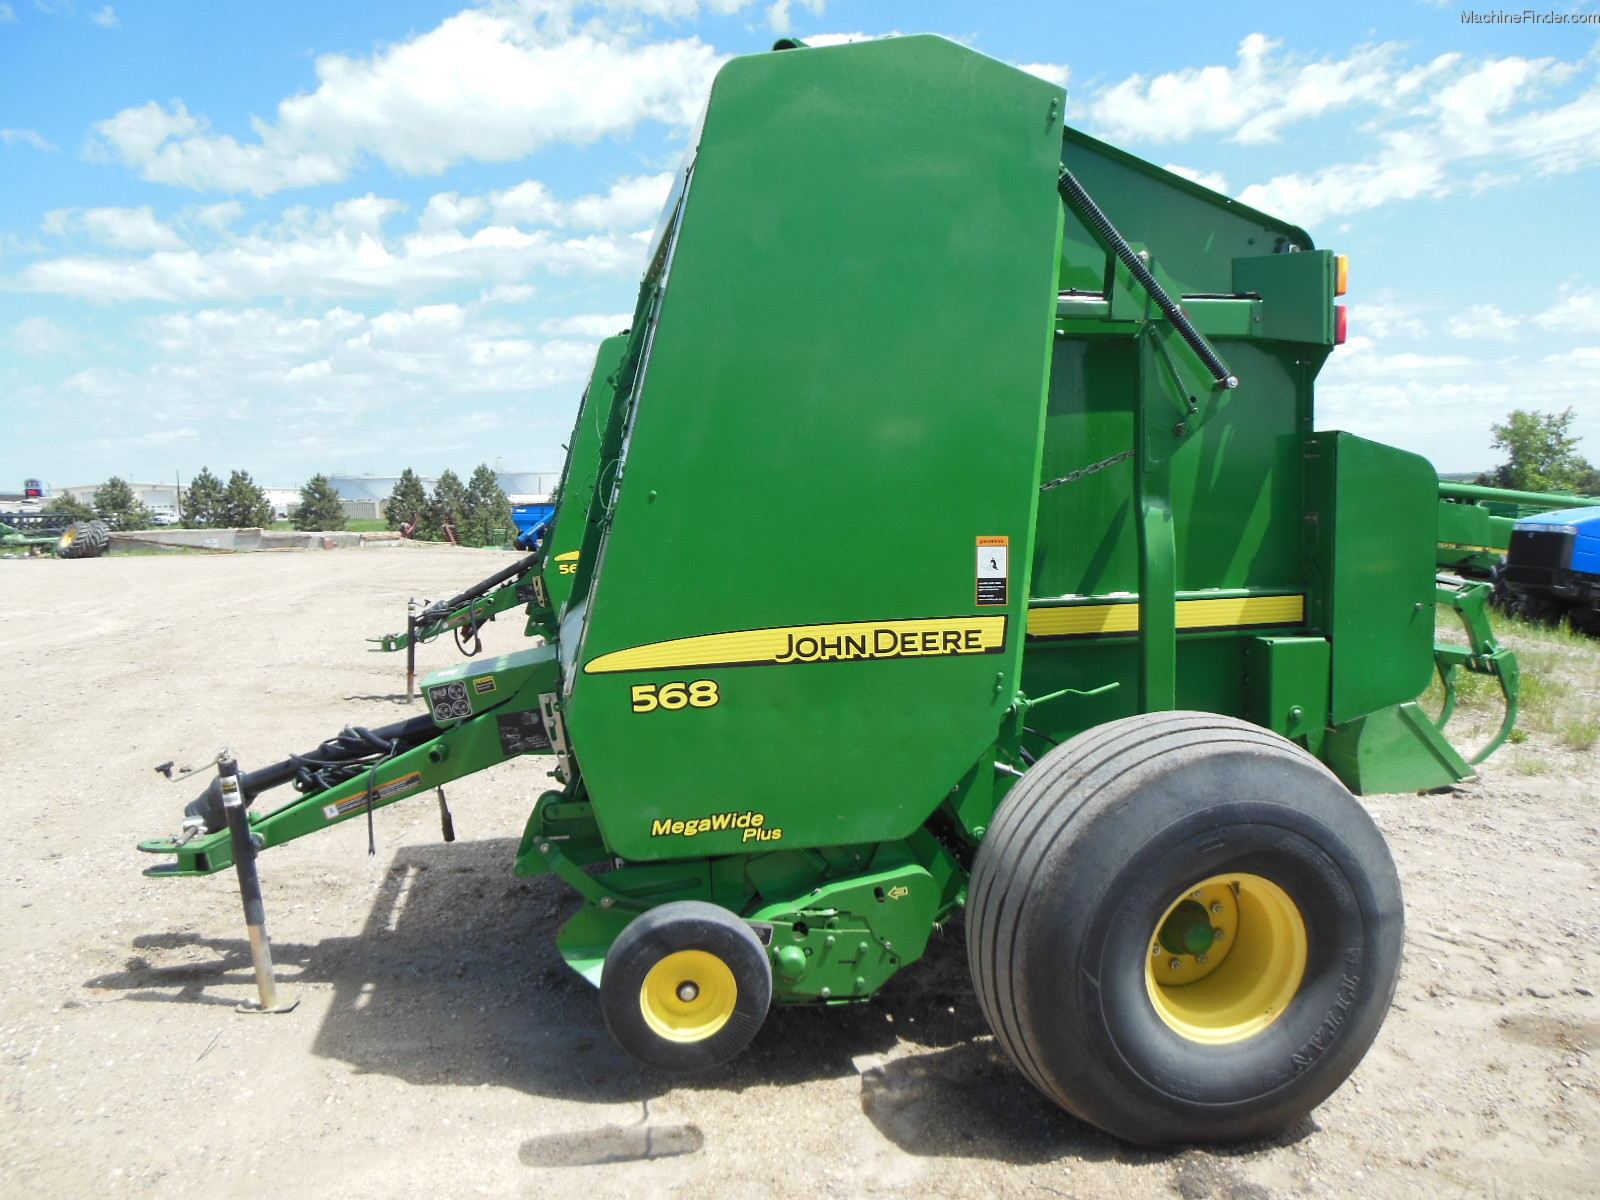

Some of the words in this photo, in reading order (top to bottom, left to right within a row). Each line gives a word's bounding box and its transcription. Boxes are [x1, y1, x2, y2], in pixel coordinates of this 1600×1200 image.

[777, 633, 866, 662] JOHN
[869, 629, 983, 659] DEERE
[631, 679, 720, 714] 568
[651, 811, 765, 836] MegaWide
[742, 828, 783, 843] Plus
